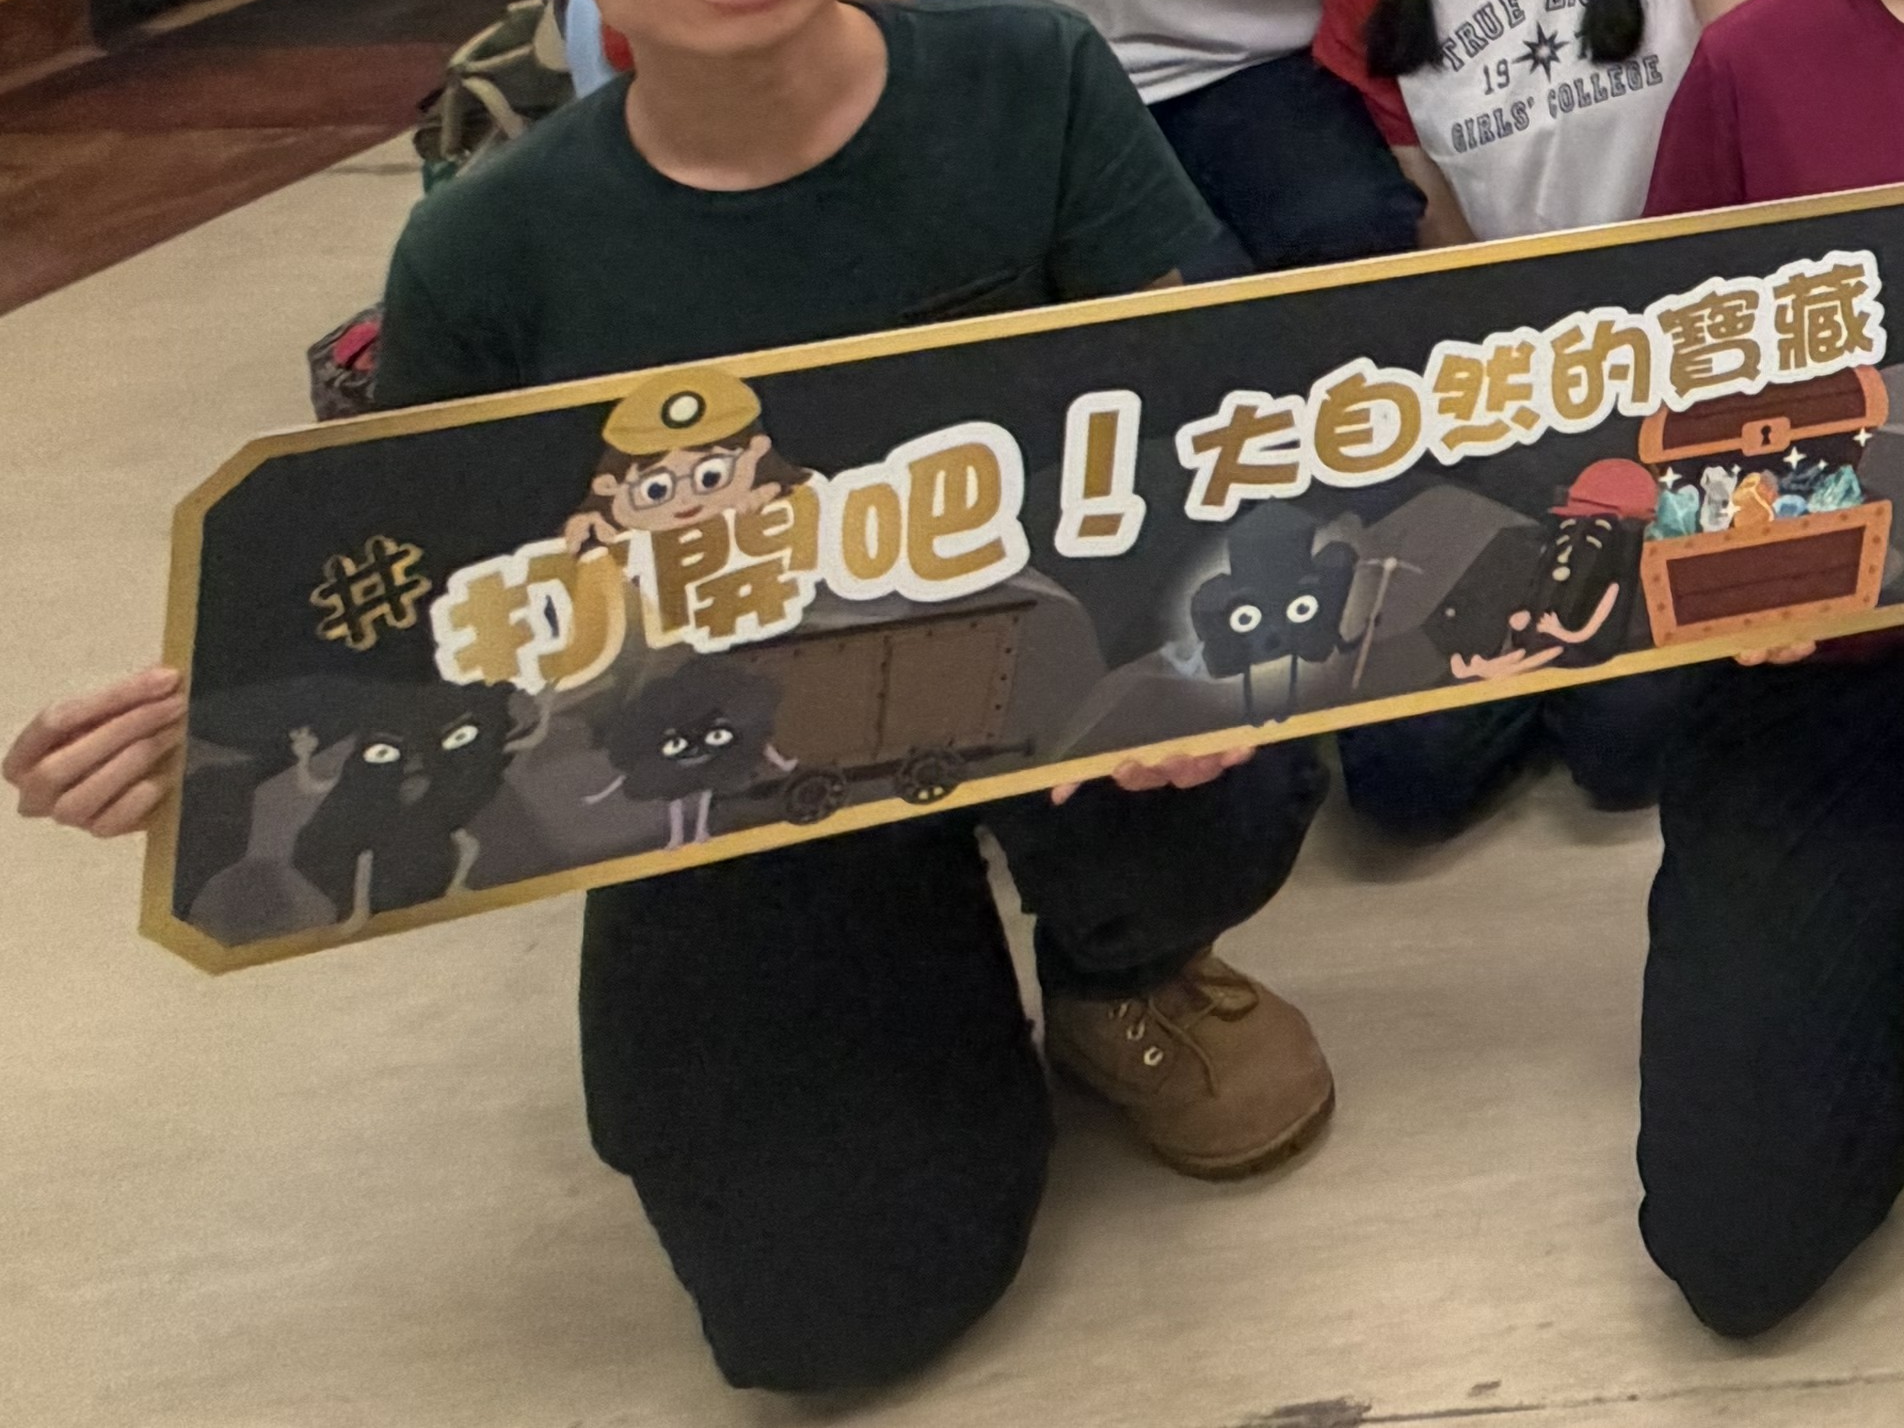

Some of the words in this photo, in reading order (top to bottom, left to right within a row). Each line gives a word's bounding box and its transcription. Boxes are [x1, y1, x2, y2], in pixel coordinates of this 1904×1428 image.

[1450, 95, 1536, 154] GIRLS'
[1547, 54, 1664, 120] COLLEGE
[1483, 58, 1510, 96] 19
